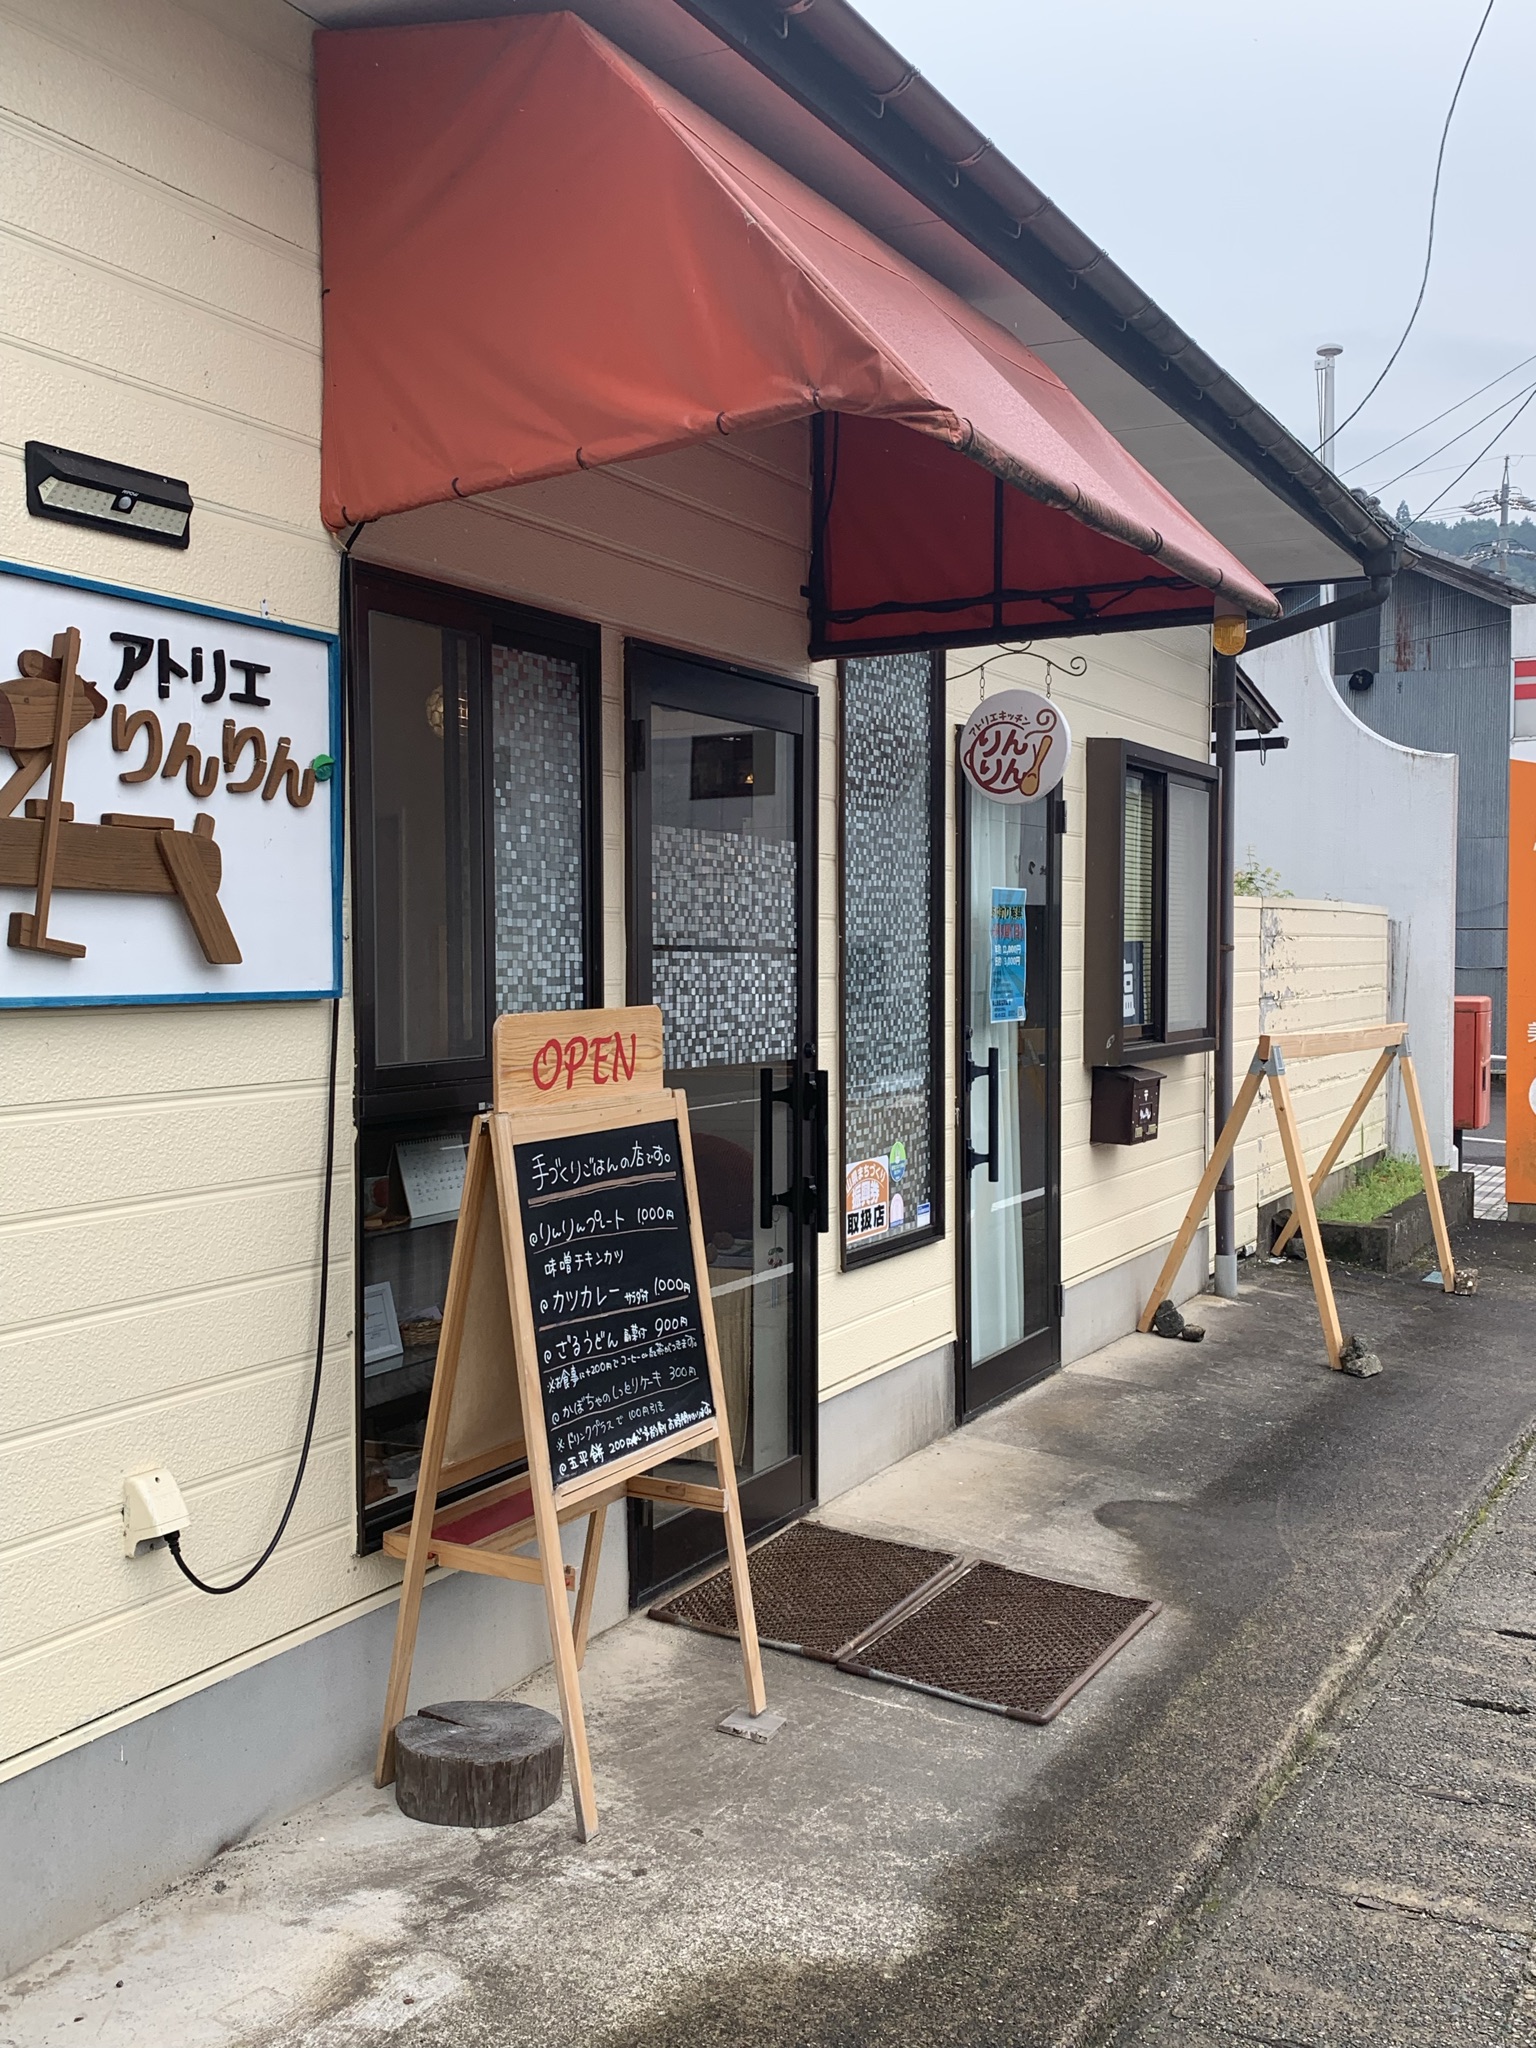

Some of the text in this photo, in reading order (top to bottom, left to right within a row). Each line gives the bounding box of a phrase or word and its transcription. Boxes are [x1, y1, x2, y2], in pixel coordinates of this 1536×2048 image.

[110, 631, 271, 707] アトリエ
[968, 710, 1031, 737] アトリエキッチン
[111, 703, 316, 808] りんりん
[979, 729, 1028, 757] りん
[980, 758, 1027, 786] りん
[532, 1031, 637, 1090] OPEN
[531, 1140, 671, 1191] 手づくりごはんの店です。
[847, 1204, 886, 1236] 取扱店
[552, 1285, 620, 1314] カツカレー
[555, 1330, 619, 1360] ざるうどん
[654, 1316, 689, 1338] 900円
[669, 1366, 697, 1381] 300円
